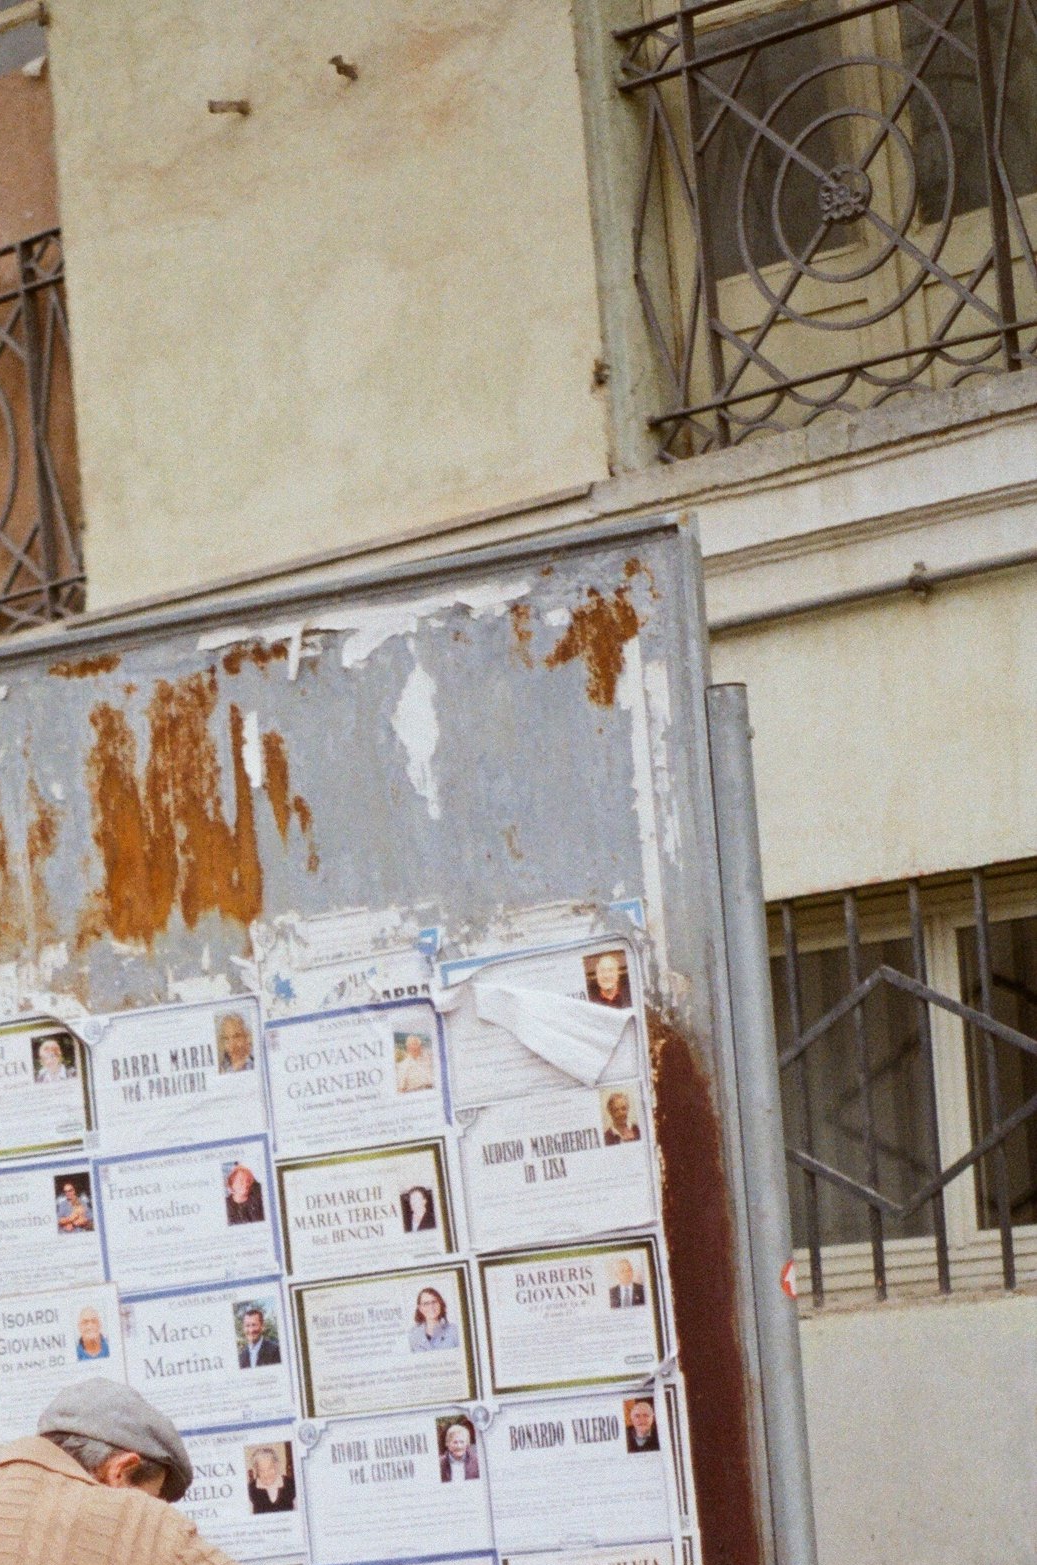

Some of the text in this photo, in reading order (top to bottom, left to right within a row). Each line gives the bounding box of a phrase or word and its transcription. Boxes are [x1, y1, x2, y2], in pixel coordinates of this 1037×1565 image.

[112, 1044, 215, 1081] BARRA MARIA
[284, 1040, 385, 1073] GIOVANNI
[287, 1068, 384, 1100] GARNERO
[530, 1127, 601, 1158] MARGHERITA
[109, 1182, 161, 1201] Franca
[305, 1185, 383, 1210] DEMARCHI
[128, 1200, 201, 1224] Mondino
[294, 1202, 398, 1230] MARIA TERESA
[515, 1265, 594, 1288] BARBERIS
[515, 1281, 596, 1305] GIOVANNI
[2, 1308, 59, 1329] ISOARDI
[147, 1322, 212, 1345] Marco
[143, 1351, 224, 1379] Martina
[509, 1415, 620, 1450] BONARDO VALERIO
[194, 1462, 237, 1480] NICA
[183, 1484, 234, 1502] RELLO
